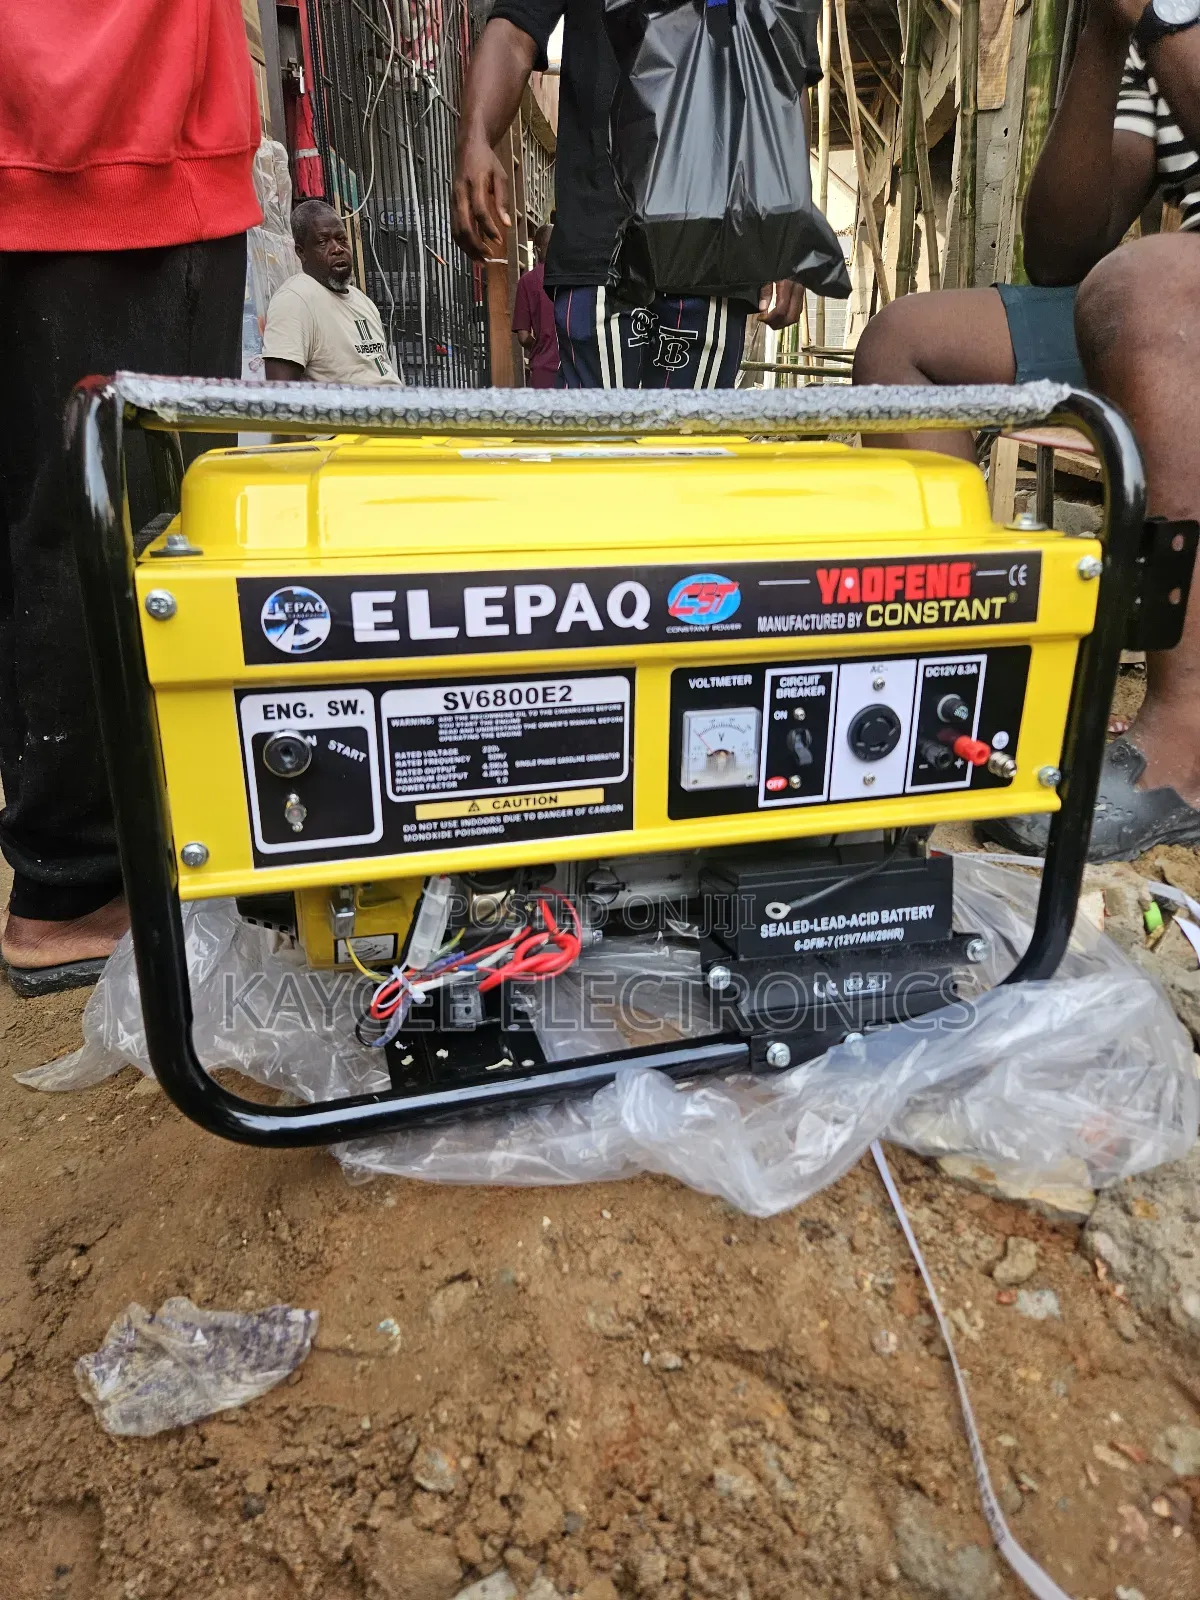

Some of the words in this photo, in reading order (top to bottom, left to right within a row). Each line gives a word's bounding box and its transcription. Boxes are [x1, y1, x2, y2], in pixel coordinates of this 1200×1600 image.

[351, 580, 651, 643] ELEPAQ
[757, 612, 847, 633] MANUFACTURED
[847, 611, 863, 628] BY
[866, 596, 1007, 627] CONSTANT
[688, 674, 753, 690] VOLTMETER
[779, 674, 821, 688] CIRCUIT
[443, 685, 573, 711] SV6800E2
[775, 685, 826, 699] BREAKER
[262, 702, 314, 720] ENG.
[327, 699, 365, 717] SW.
[773, 710, 788, 720] ON
[328, 739, 367, 762] START
[492, 795, 559, 810] CAUTION
[403, 823, 417, 833] DO
[419, 822, 438, 831] NOT
[440, 820, 458, 830] USE
[460, 816, 502, 827] INDOORS
[503, 814, 521, 824] DUE
[523, 812, 536, 821] TO
[537, 809, 574, 820] DANGER
[574, 807, 586, 816] OF
[588, 803, 624, 815] CARBON
[403, 831, 453, 843] MONOXIDE
[455, 825, 505, 838] POISONING
[760, 911, 879, 938] SEALED-LEAD-ACID
[880, 904, 935, 924] BATTERY
